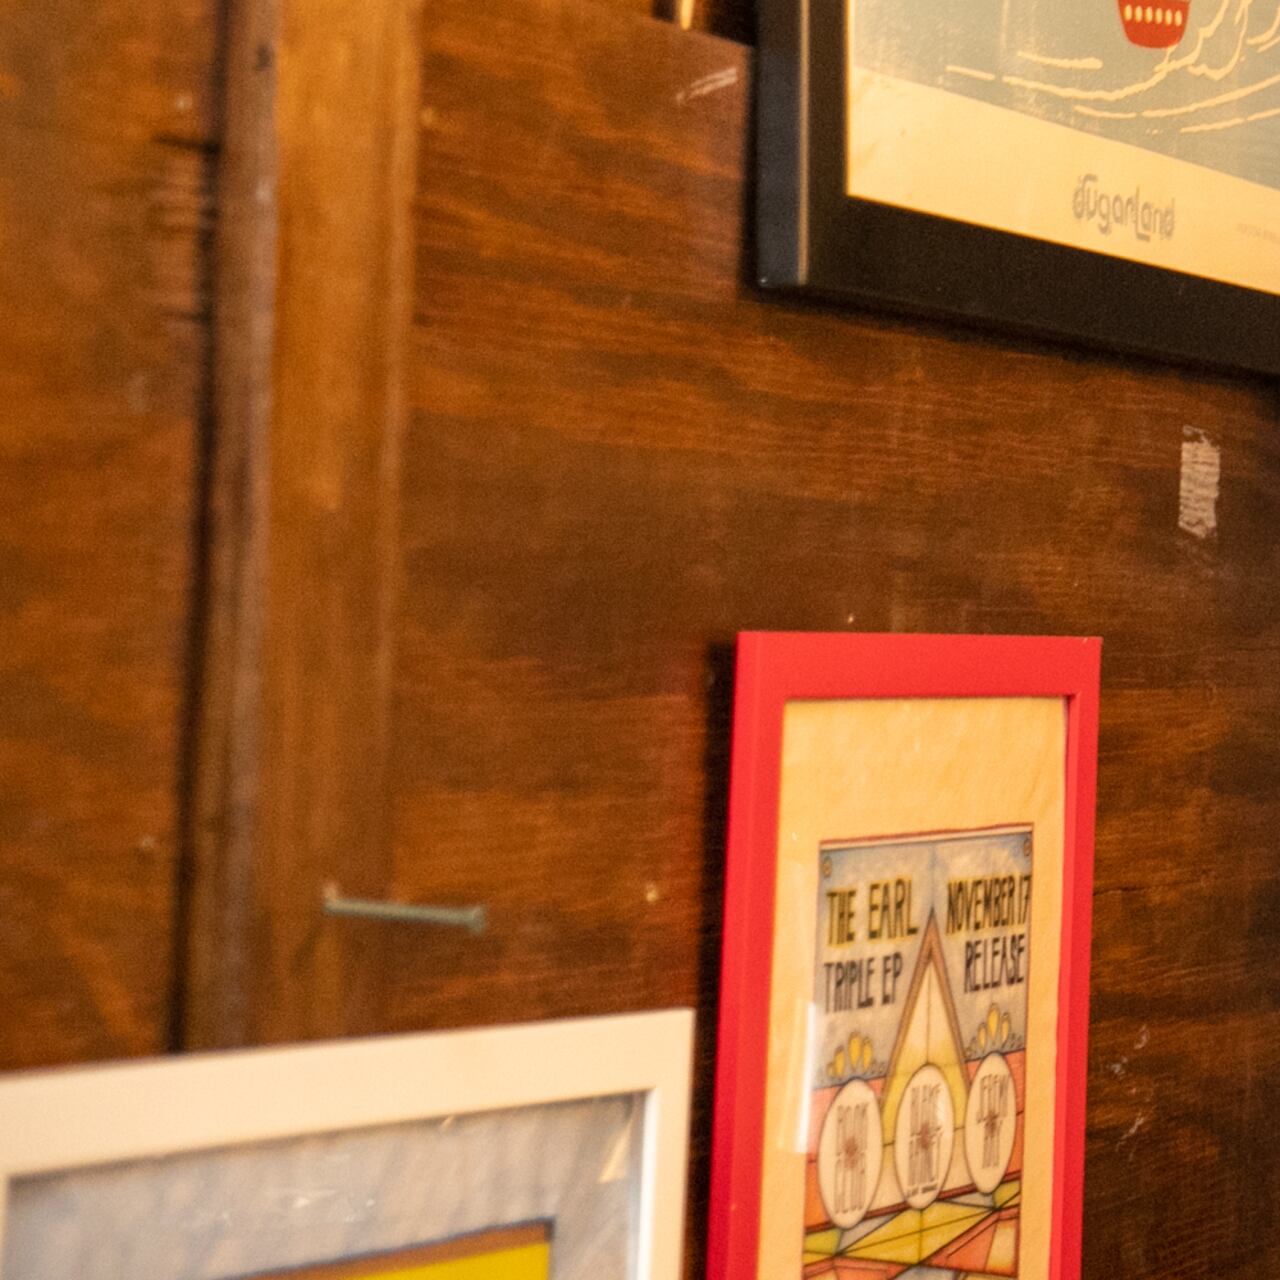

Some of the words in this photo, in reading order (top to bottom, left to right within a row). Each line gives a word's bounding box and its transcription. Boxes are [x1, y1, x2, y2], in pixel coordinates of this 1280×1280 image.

[826, 889, 857, 946] THE
[868, 878, 919, 940] EARL
[946, 875, 1016, 935] NOVEMBER
[1018, 874, 1032, 925] 17
[824, 957, 875, 1014] TRIPLE
[882, 951, 903, 1005] EP
[964, 933, 1026, 994] RELEASE
